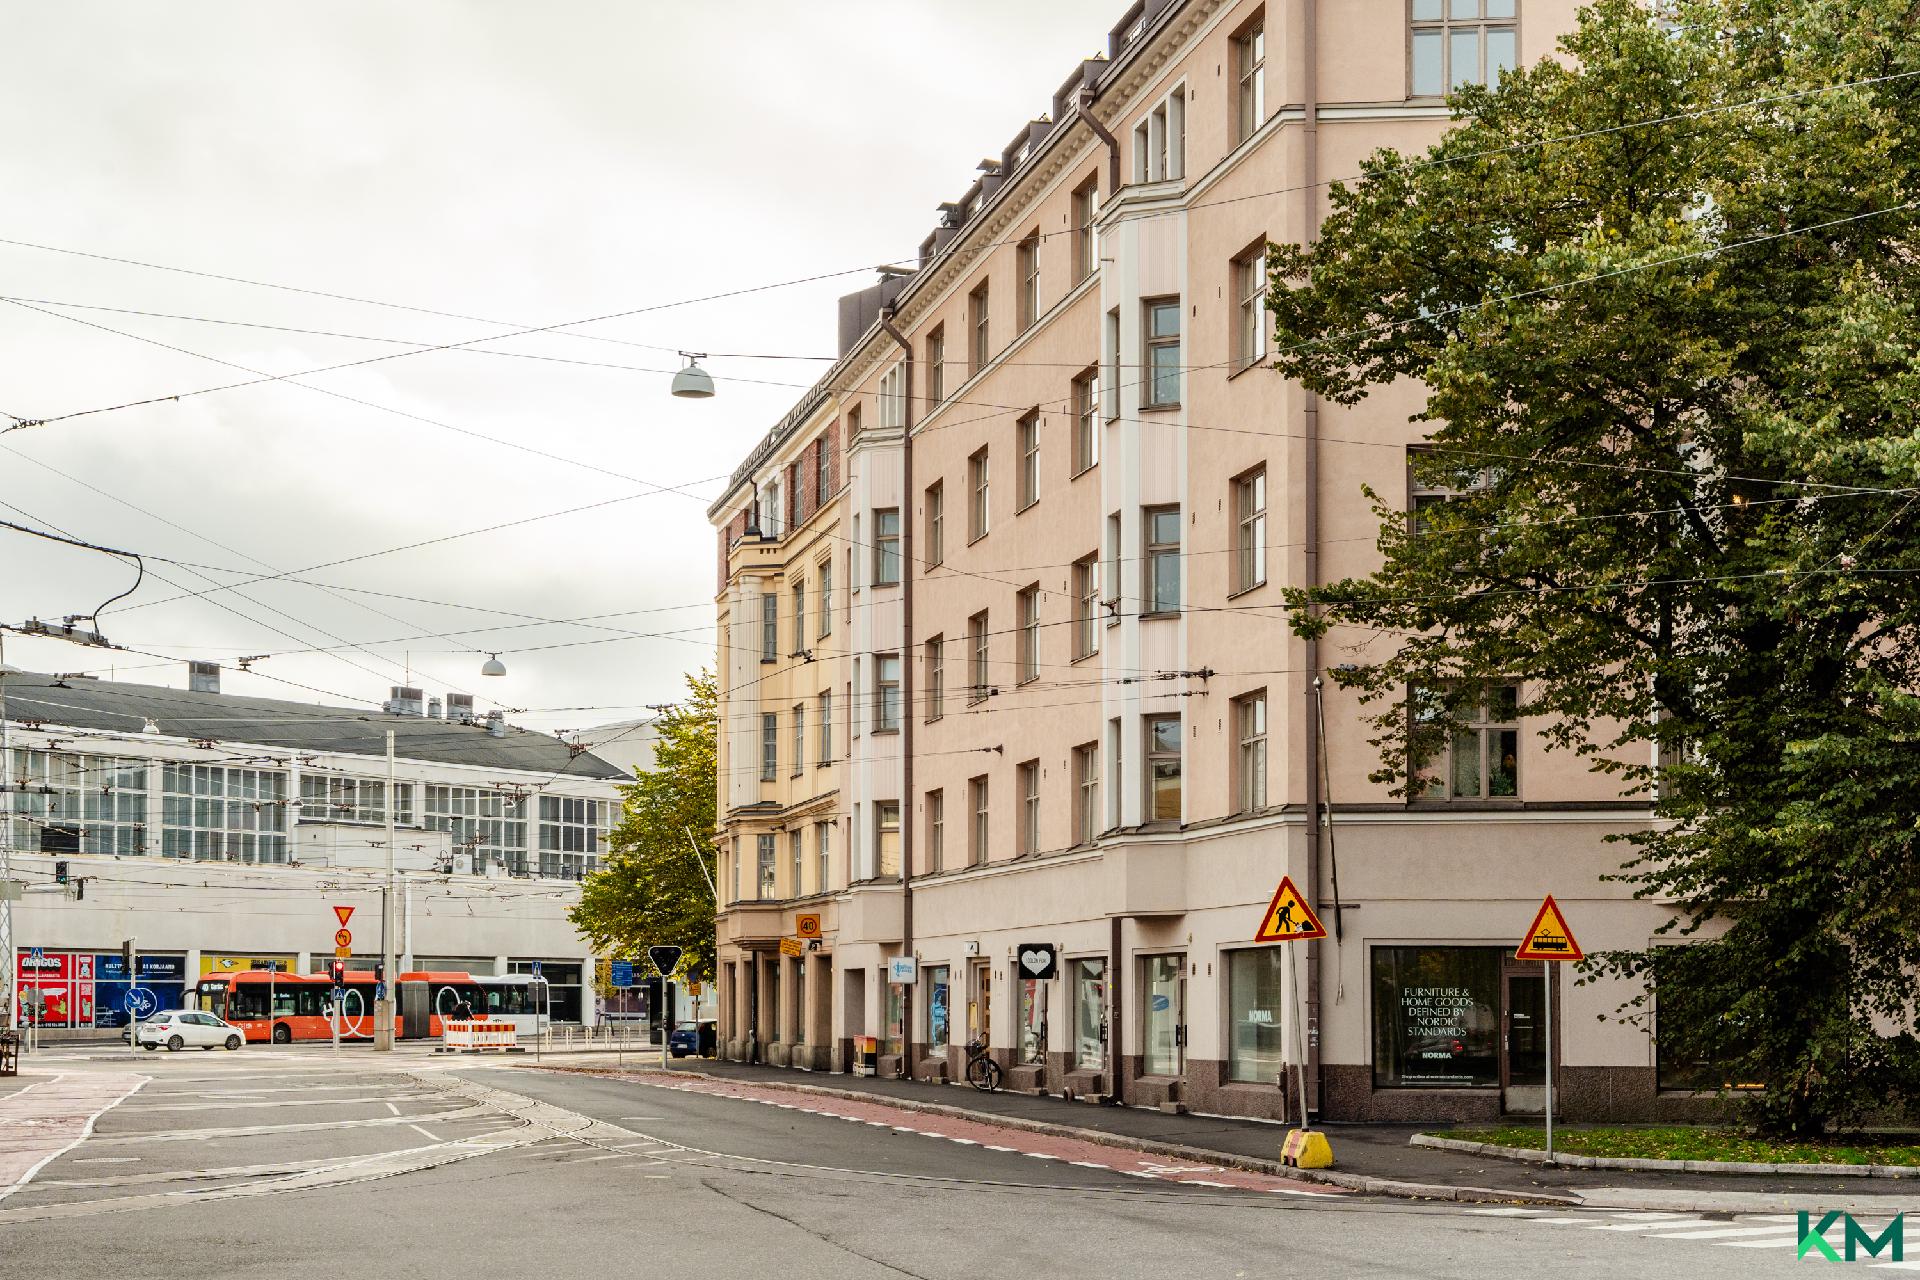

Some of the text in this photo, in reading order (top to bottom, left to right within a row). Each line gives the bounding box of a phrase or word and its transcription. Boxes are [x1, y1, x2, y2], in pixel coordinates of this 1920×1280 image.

[803, 921, 814, 931] 40
[1404, 987, 1470, 997] FURNITURE &
[1401, 997, 1474, 1006] HOME GOODS
[1248, 1009, 1273, 1023] NORMA
[1408, 1007, 1466, 1017] DEFINED BY
[1417, 1017, 1458, 1026] NORDIC
[1407, 1026, 1467, 1037] STANDARDS
